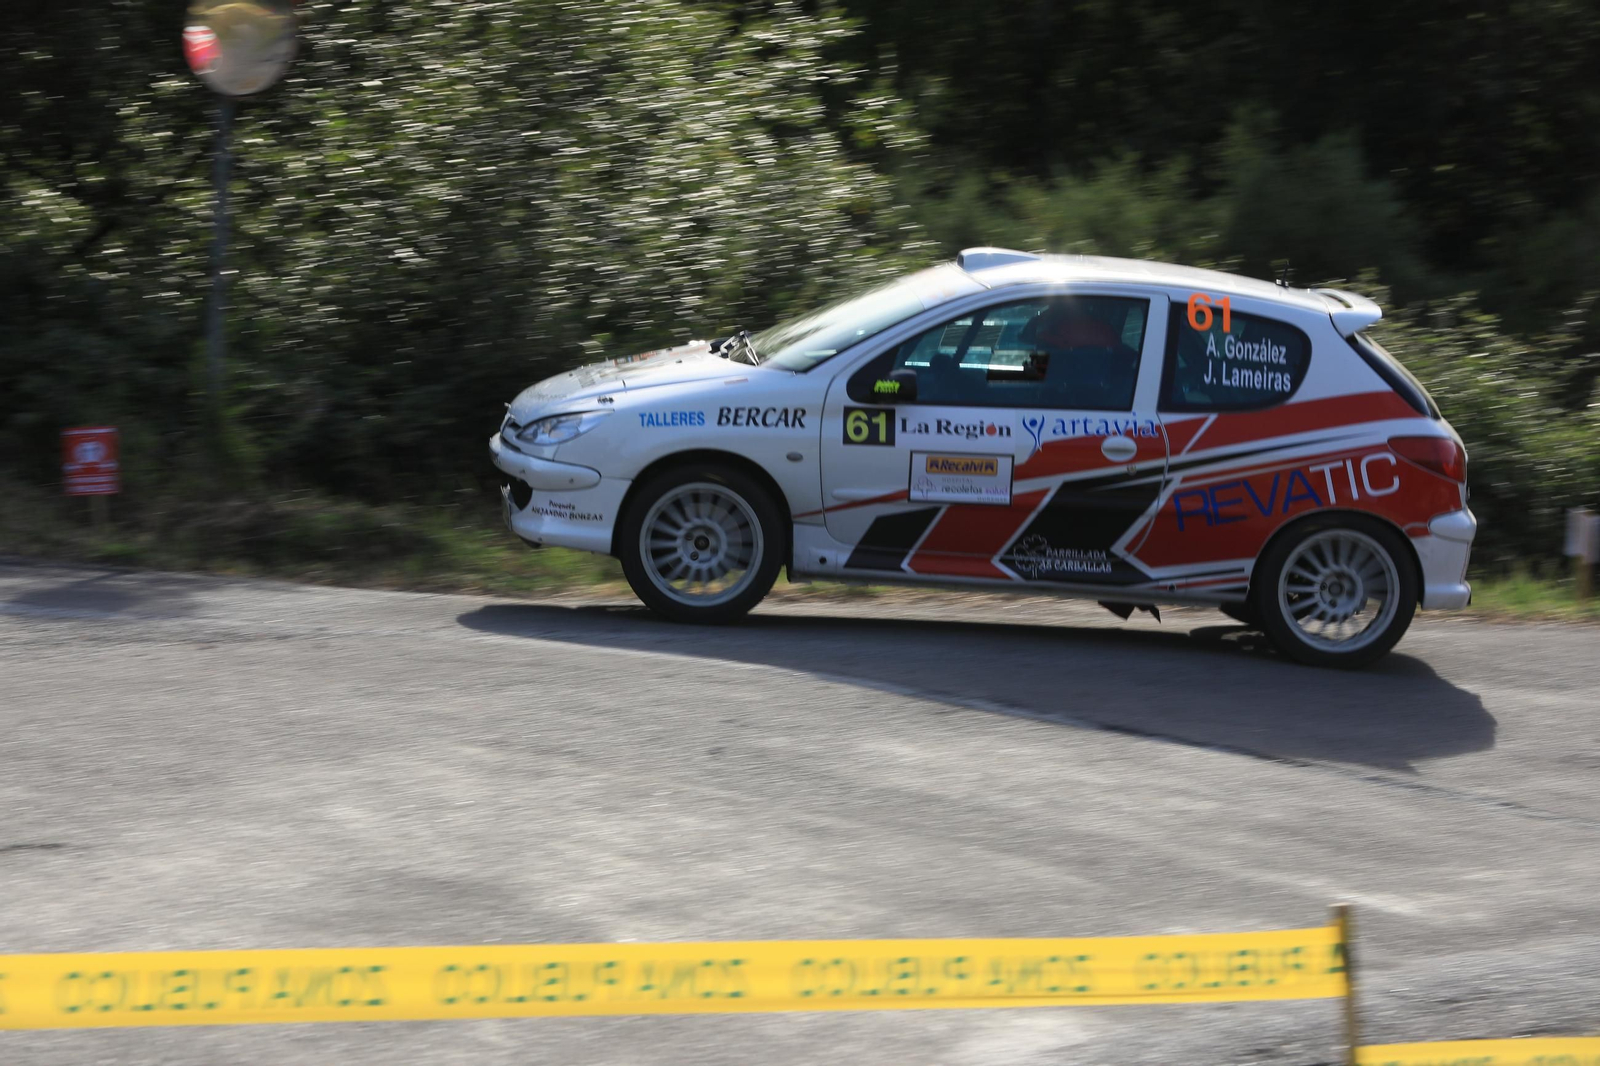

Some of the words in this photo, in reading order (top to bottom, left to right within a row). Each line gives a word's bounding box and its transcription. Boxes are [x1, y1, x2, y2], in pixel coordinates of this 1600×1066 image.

[1187, 293, 1231, 333] 61
[1206, 333, 1220, 358] A.
[1225, 336, 1286, 364] González
[1204, 360, 1216, 385] J.
[1222, 362, 1291, 392] Lameiras
[639, 411, 706, 428] TALLERES
[717, 406, 807, 429] BERCAR
[846, 410, 887, 443] 61
[901, 415, 929, 435] La
[1052, 412, 1159, 438] artavia
[940, 459, 983, 474] Recalvi
[1172, 452, 1400, 532] REVATIC
[1046, 546, 1107, 560] PARRILLADA
[1054, 560, 1112, 574] CARBALLAS
